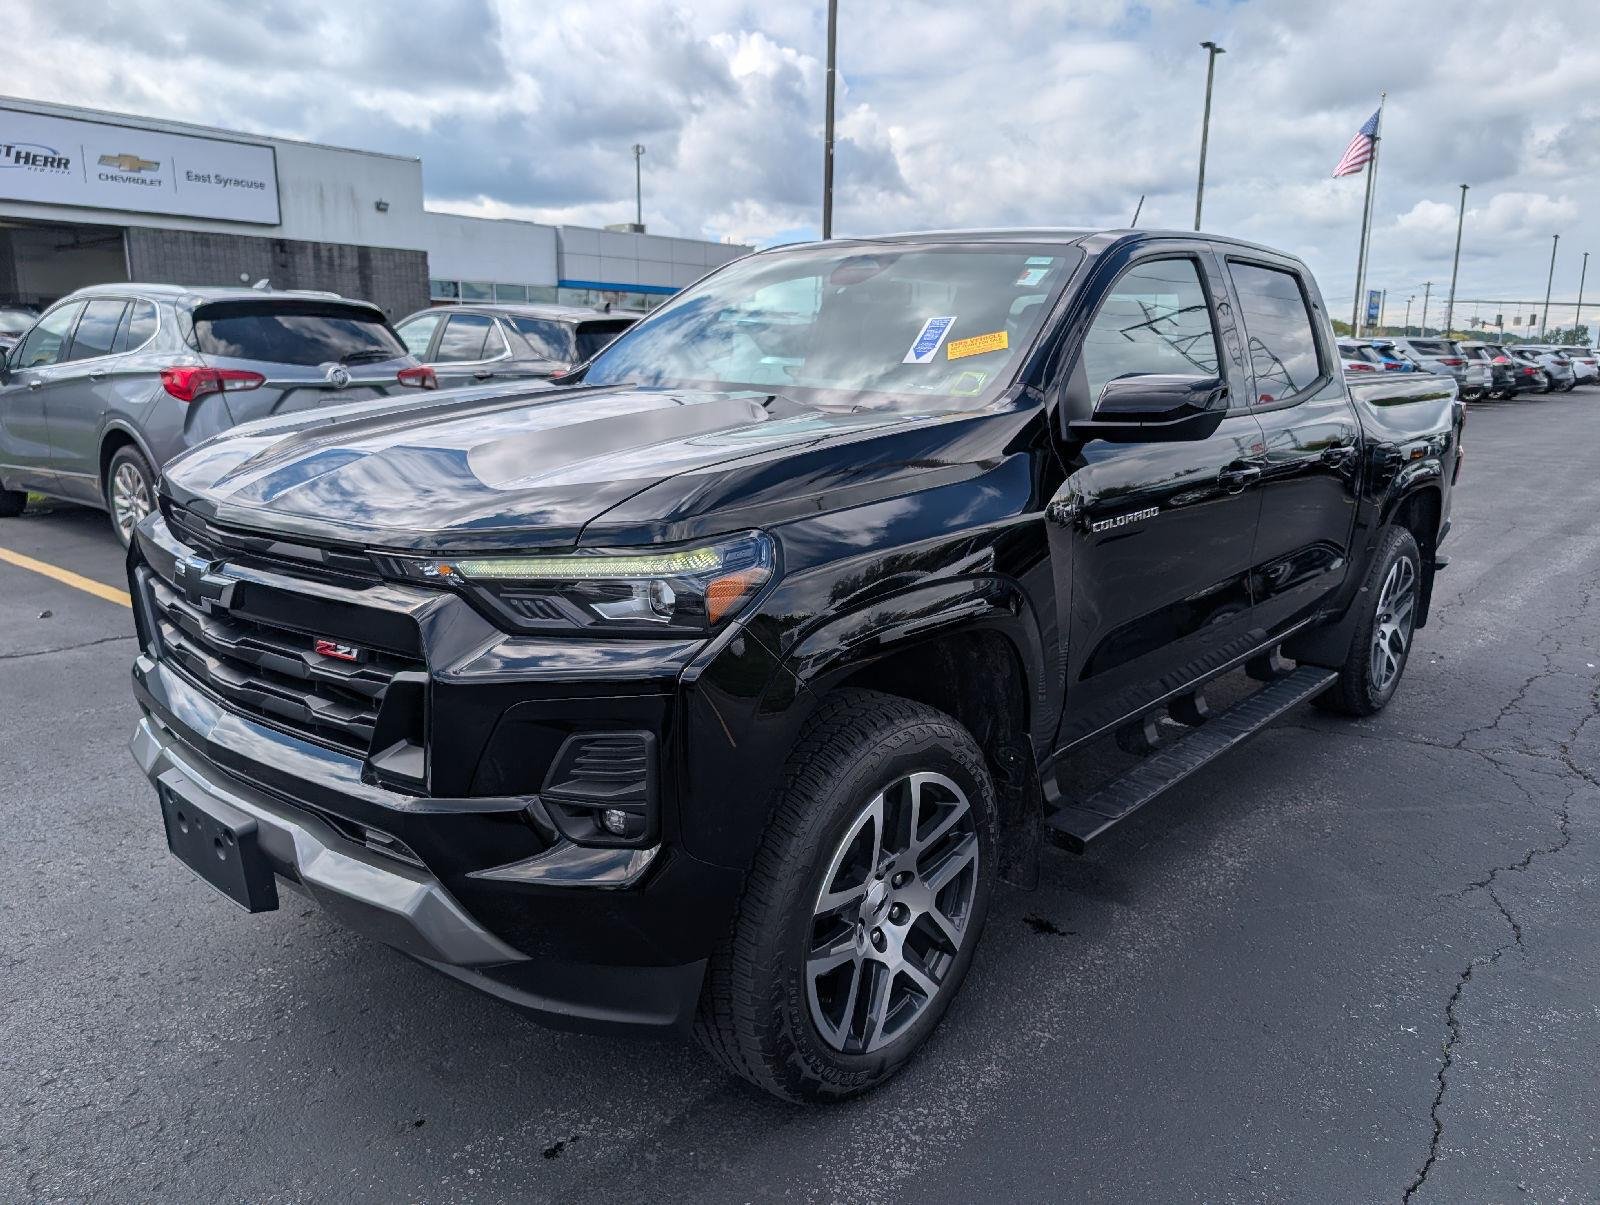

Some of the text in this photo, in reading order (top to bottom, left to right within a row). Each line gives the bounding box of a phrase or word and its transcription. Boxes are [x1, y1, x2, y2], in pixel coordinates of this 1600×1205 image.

[14, 150, 71, 170] HERR
[98, 172, 162, 187] CHEVROLET
[186, 169, 266, 190] East Syracuse
[1092, 506, 1160, 533] COLORADO
[315, 639, 359, 661] Z71
